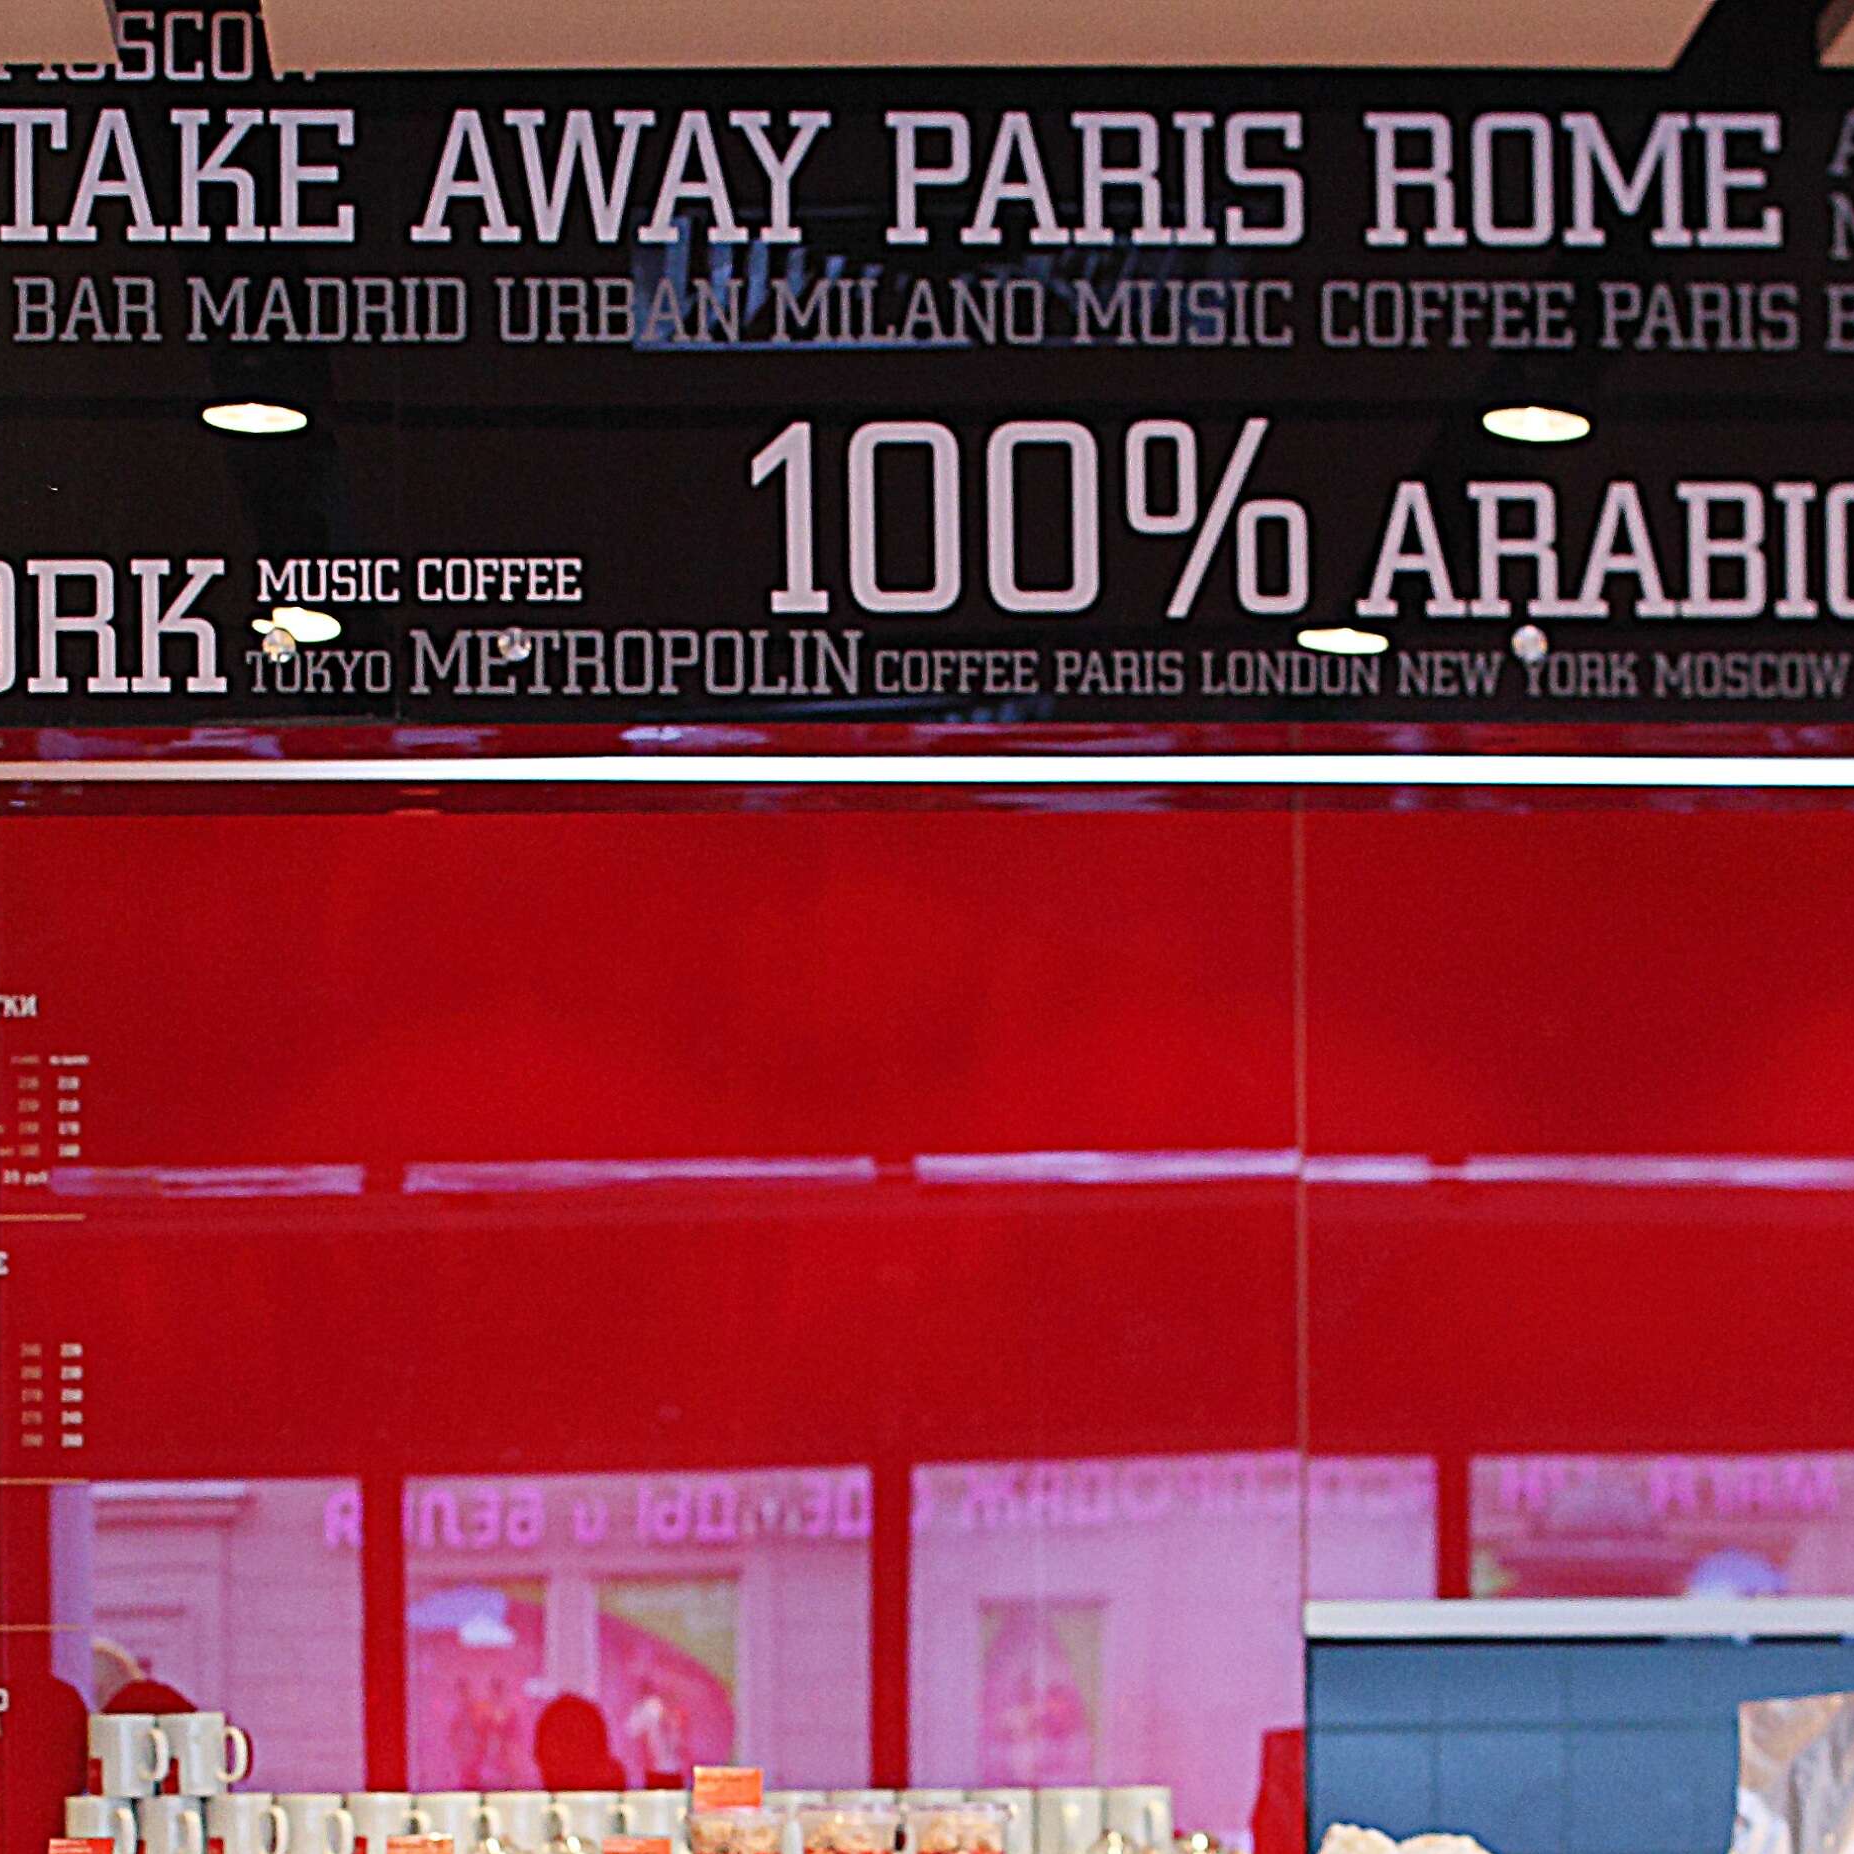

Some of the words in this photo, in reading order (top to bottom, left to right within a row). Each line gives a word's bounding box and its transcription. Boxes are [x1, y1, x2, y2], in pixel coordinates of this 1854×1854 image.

[411, 109, 831, 243] AWAY
[885, 111, 1303, 246] PARIS
[1362, 111, 1783, 247] ROME
[14, 276, 161, 342] BAR
[186, 277, 465, 344] MADRID
[497, 277, 749, 343] URBAN
[770, 279, 1045, 345] MILANO
[1075, 281, 1294, 346] MUSIC
[1320, 281, 1575, 348] COFFEE
[1600, 282, 1798, 349] PARIS
[751, 418, 1307, 619] 100%
[257, 559, 400, 602] MUSIC
[417, 558, 582, 601] COFFEE
[244, 650, 391, 694] TOKYO
[411, 630, 863, 697] METROPOLIN
[875, 650, 1039, 695] COFFEE
[1054, 652, 1183, 696] PARIS
[1200, 652, 1384, 696] LONDON
[1398, 653, 1502, 697] NEW
[1521, 652, 1637, 697] YORK
[1654, 653, 1850, 700] MOSCOW
